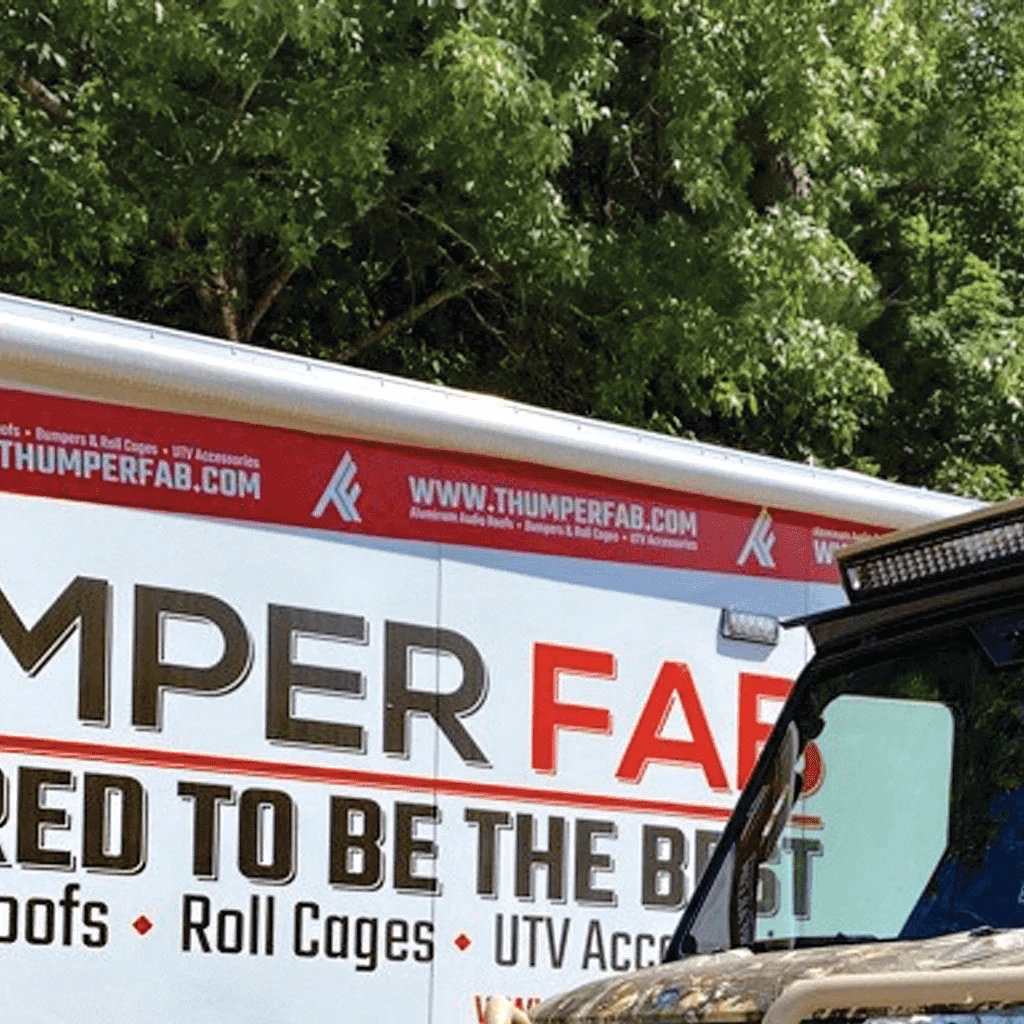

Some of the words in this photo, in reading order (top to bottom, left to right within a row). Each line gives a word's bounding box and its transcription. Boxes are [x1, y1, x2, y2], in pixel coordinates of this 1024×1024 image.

[0, 439, 261, 500] THUMPERFAB.COM
[35, 427, 87, 446] Bumpers
[89, 434, 98, 448] &
[100, 434, 122, 451] Roll
[124, 438, 158, 456] Cages
[172, 444, 194, 460] UTV
[195, 447, 260, 469] Accessories
[408, 475, 698, 537] WWW.THUMPERFAB.COM
[530, 641, 826, 798] FAB
[0, 765, 149, 876] ED
[177, 780, 298, 885] TO
[328, 794, 441, 896] BE
[464, 808, 618, 908] THE
[182, 893, 275, 956] Roll
[293, 900, 435, 972] Cages
[494, 913, 571, 969] UTV
